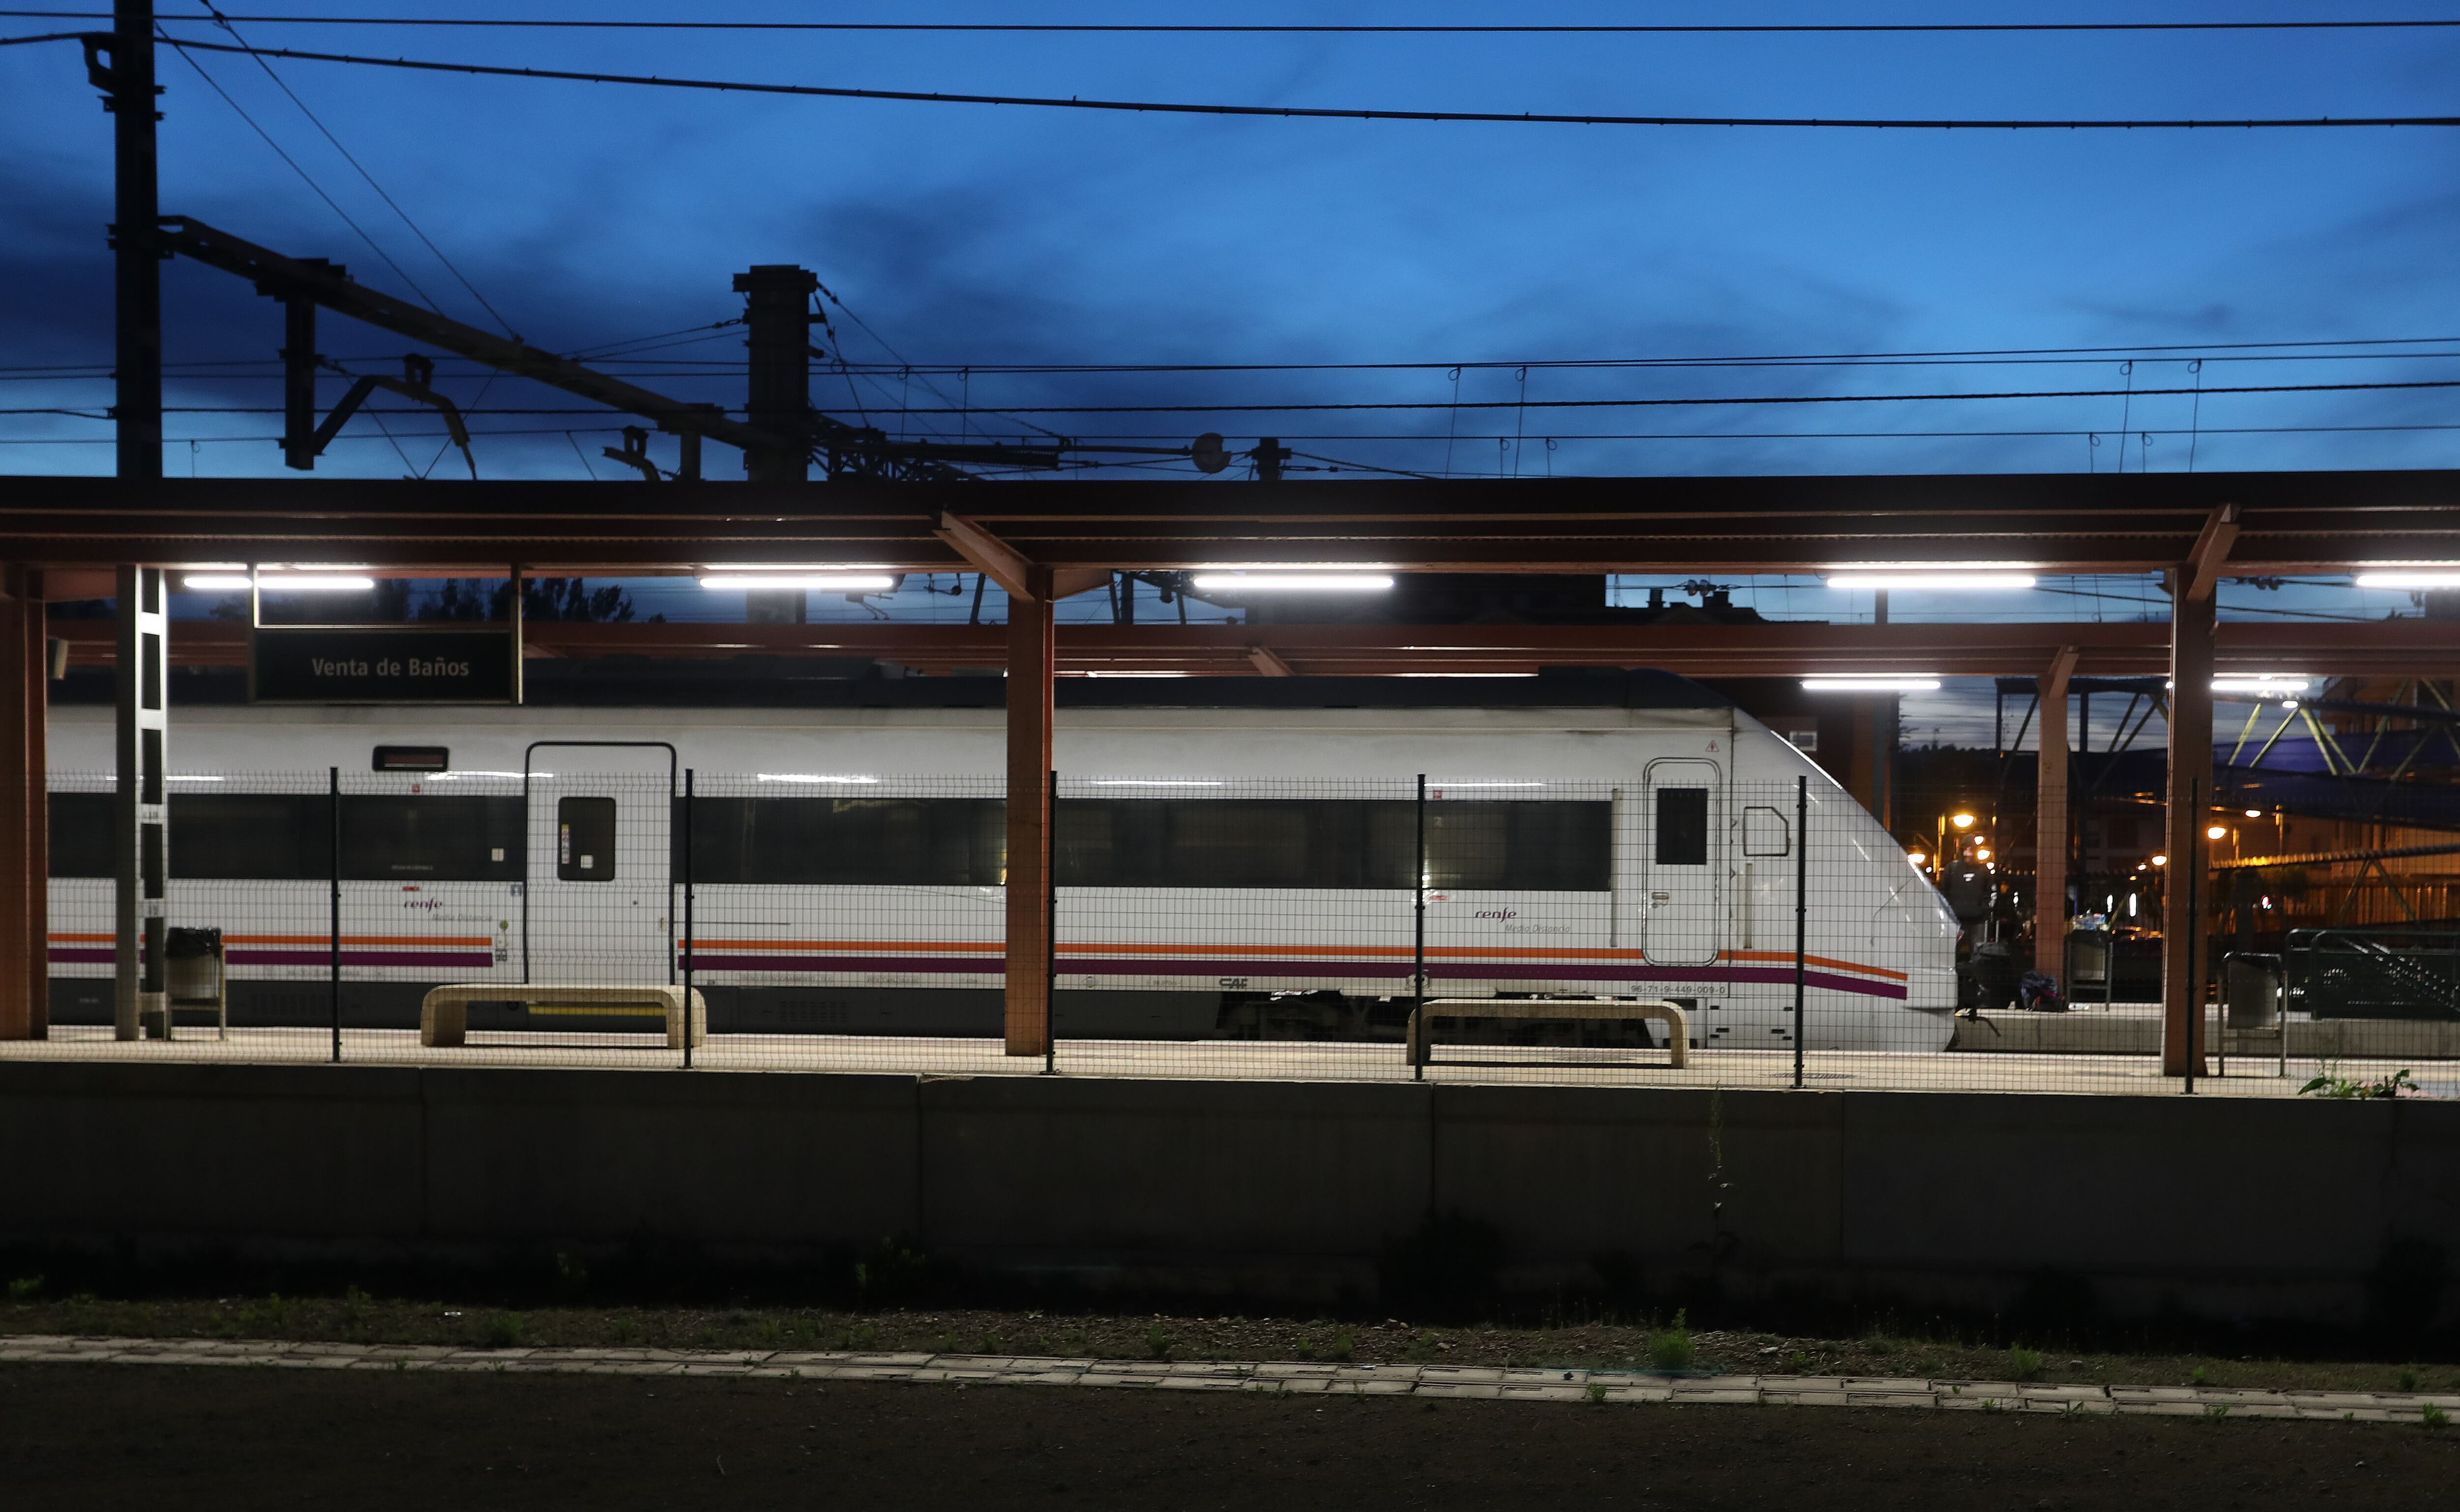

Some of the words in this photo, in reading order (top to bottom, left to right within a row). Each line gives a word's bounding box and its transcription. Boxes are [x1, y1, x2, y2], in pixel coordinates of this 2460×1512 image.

[311, 658, 368, 676] Venta
[376, 658, 401, 676] de
[409, 656, 469, 676] Baños
[404, 897, 442, 913] renfe
[1476, 907, 1516, 923] renfe
[1505, 924, 1530, 933] Media
